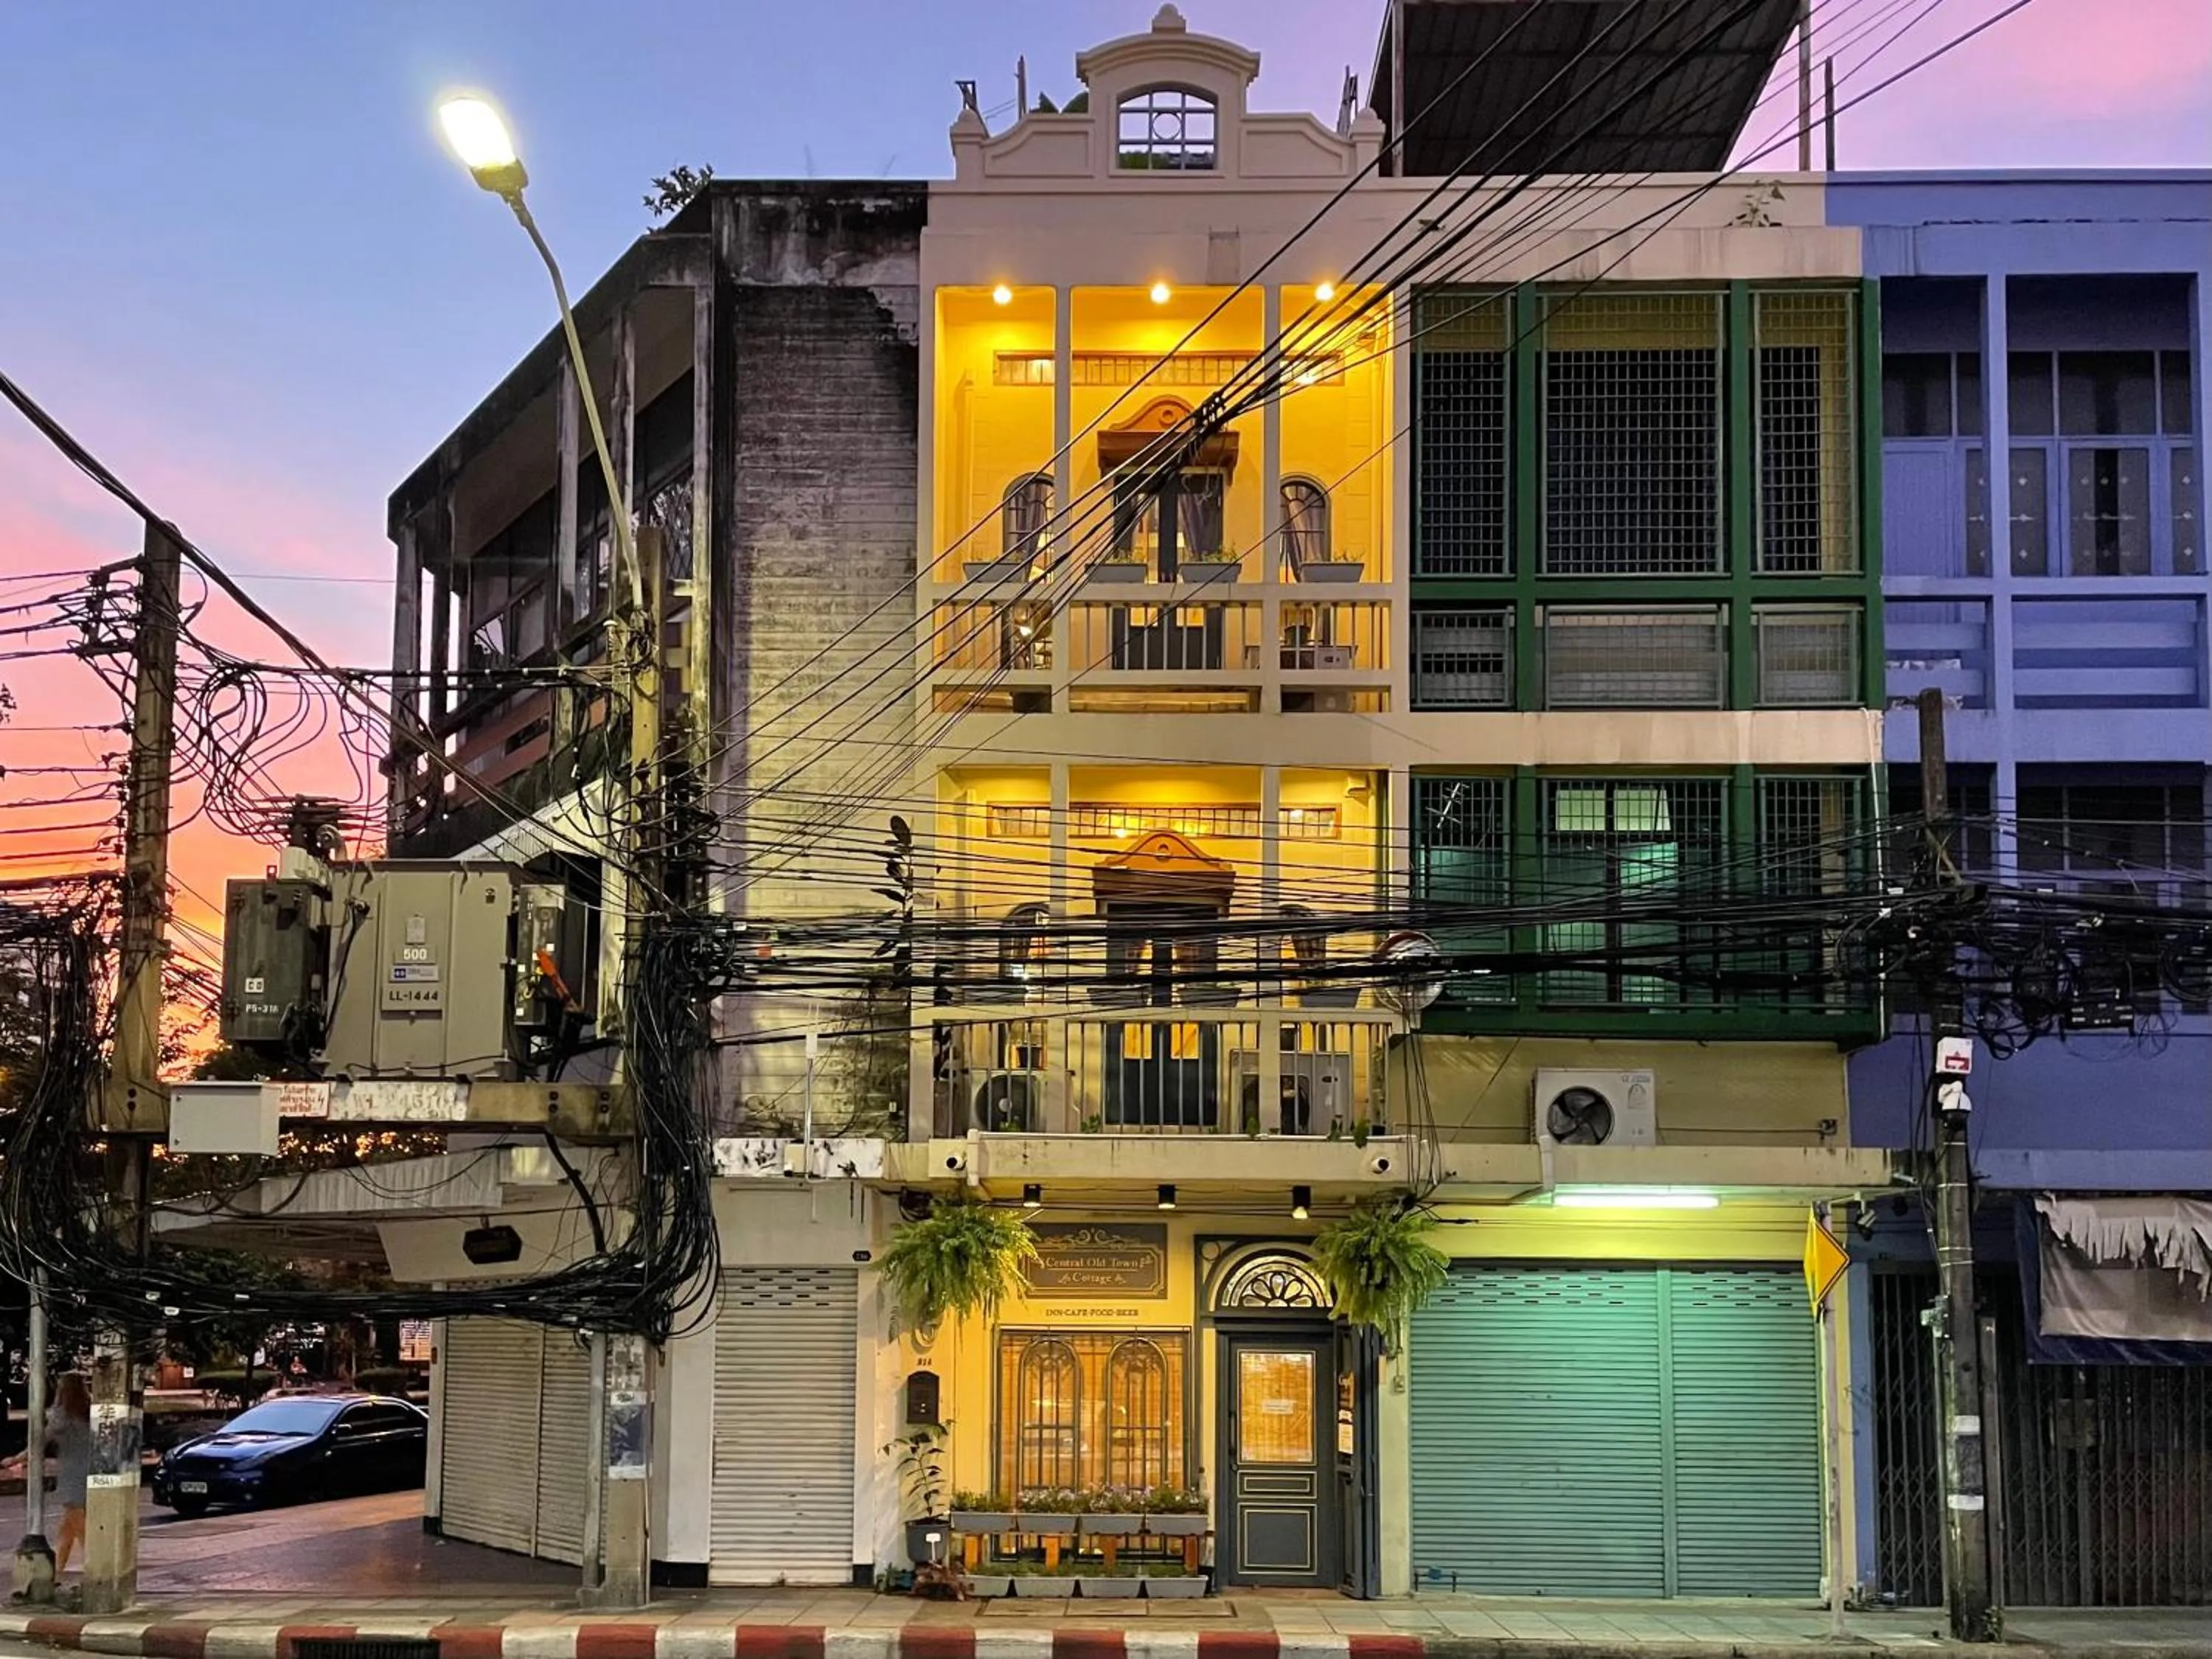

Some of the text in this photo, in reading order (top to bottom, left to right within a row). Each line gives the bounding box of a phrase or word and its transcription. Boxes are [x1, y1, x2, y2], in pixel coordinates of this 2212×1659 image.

[403, 948, 427, 960] 500
[389, 990, 439, 1001] LL-1444
[1046, 1256, 1138, 1267] Central Old Town
[1072, 1272, 1113, 1285] Cottage
